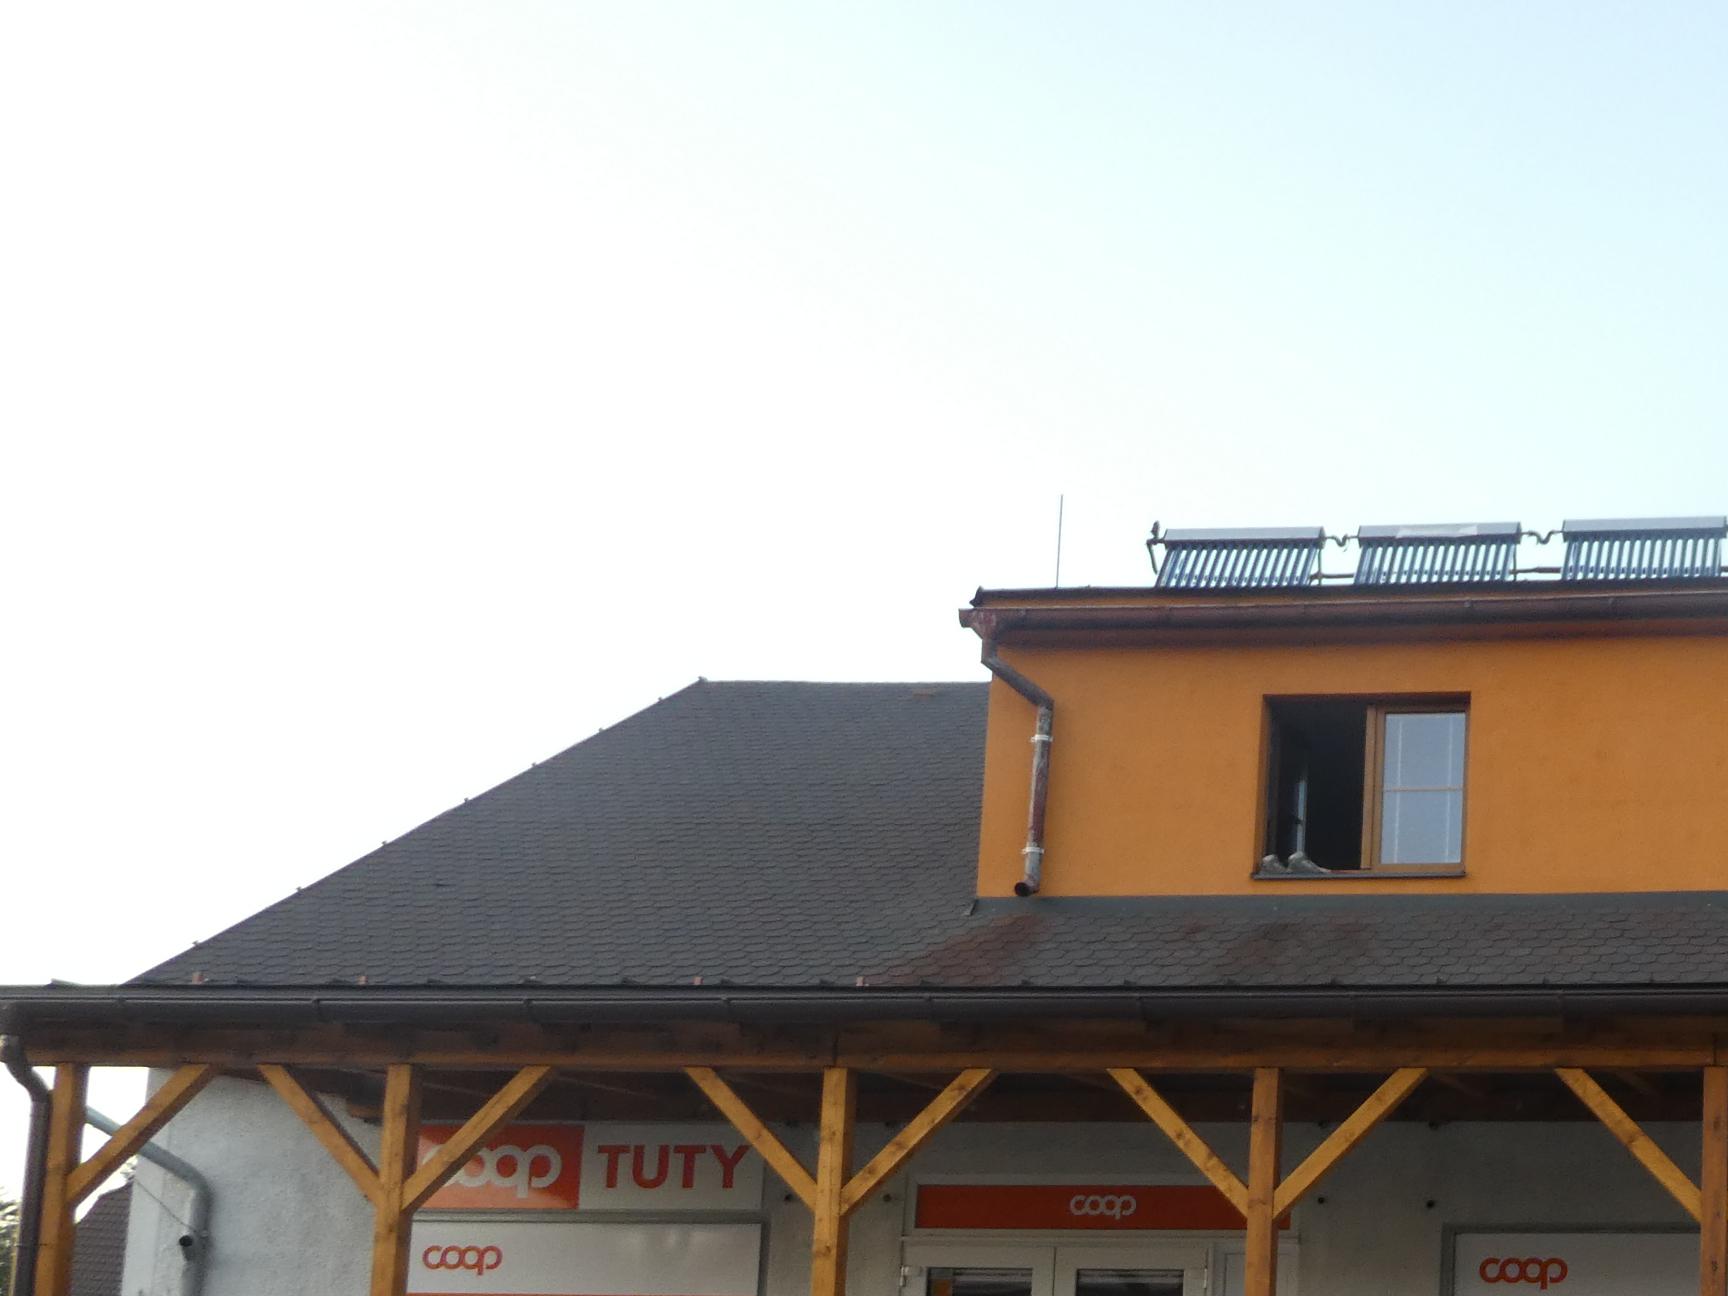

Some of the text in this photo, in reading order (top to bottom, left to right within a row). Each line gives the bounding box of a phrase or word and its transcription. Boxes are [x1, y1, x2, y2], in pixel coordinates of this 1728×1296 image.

[597, 1144, 750, 1189] TUTY
[1070, 1194, 1137, 1220] coop
[422, 1245, 503, 1276] coop
[1479, 1257, 1569, 1291] coop
